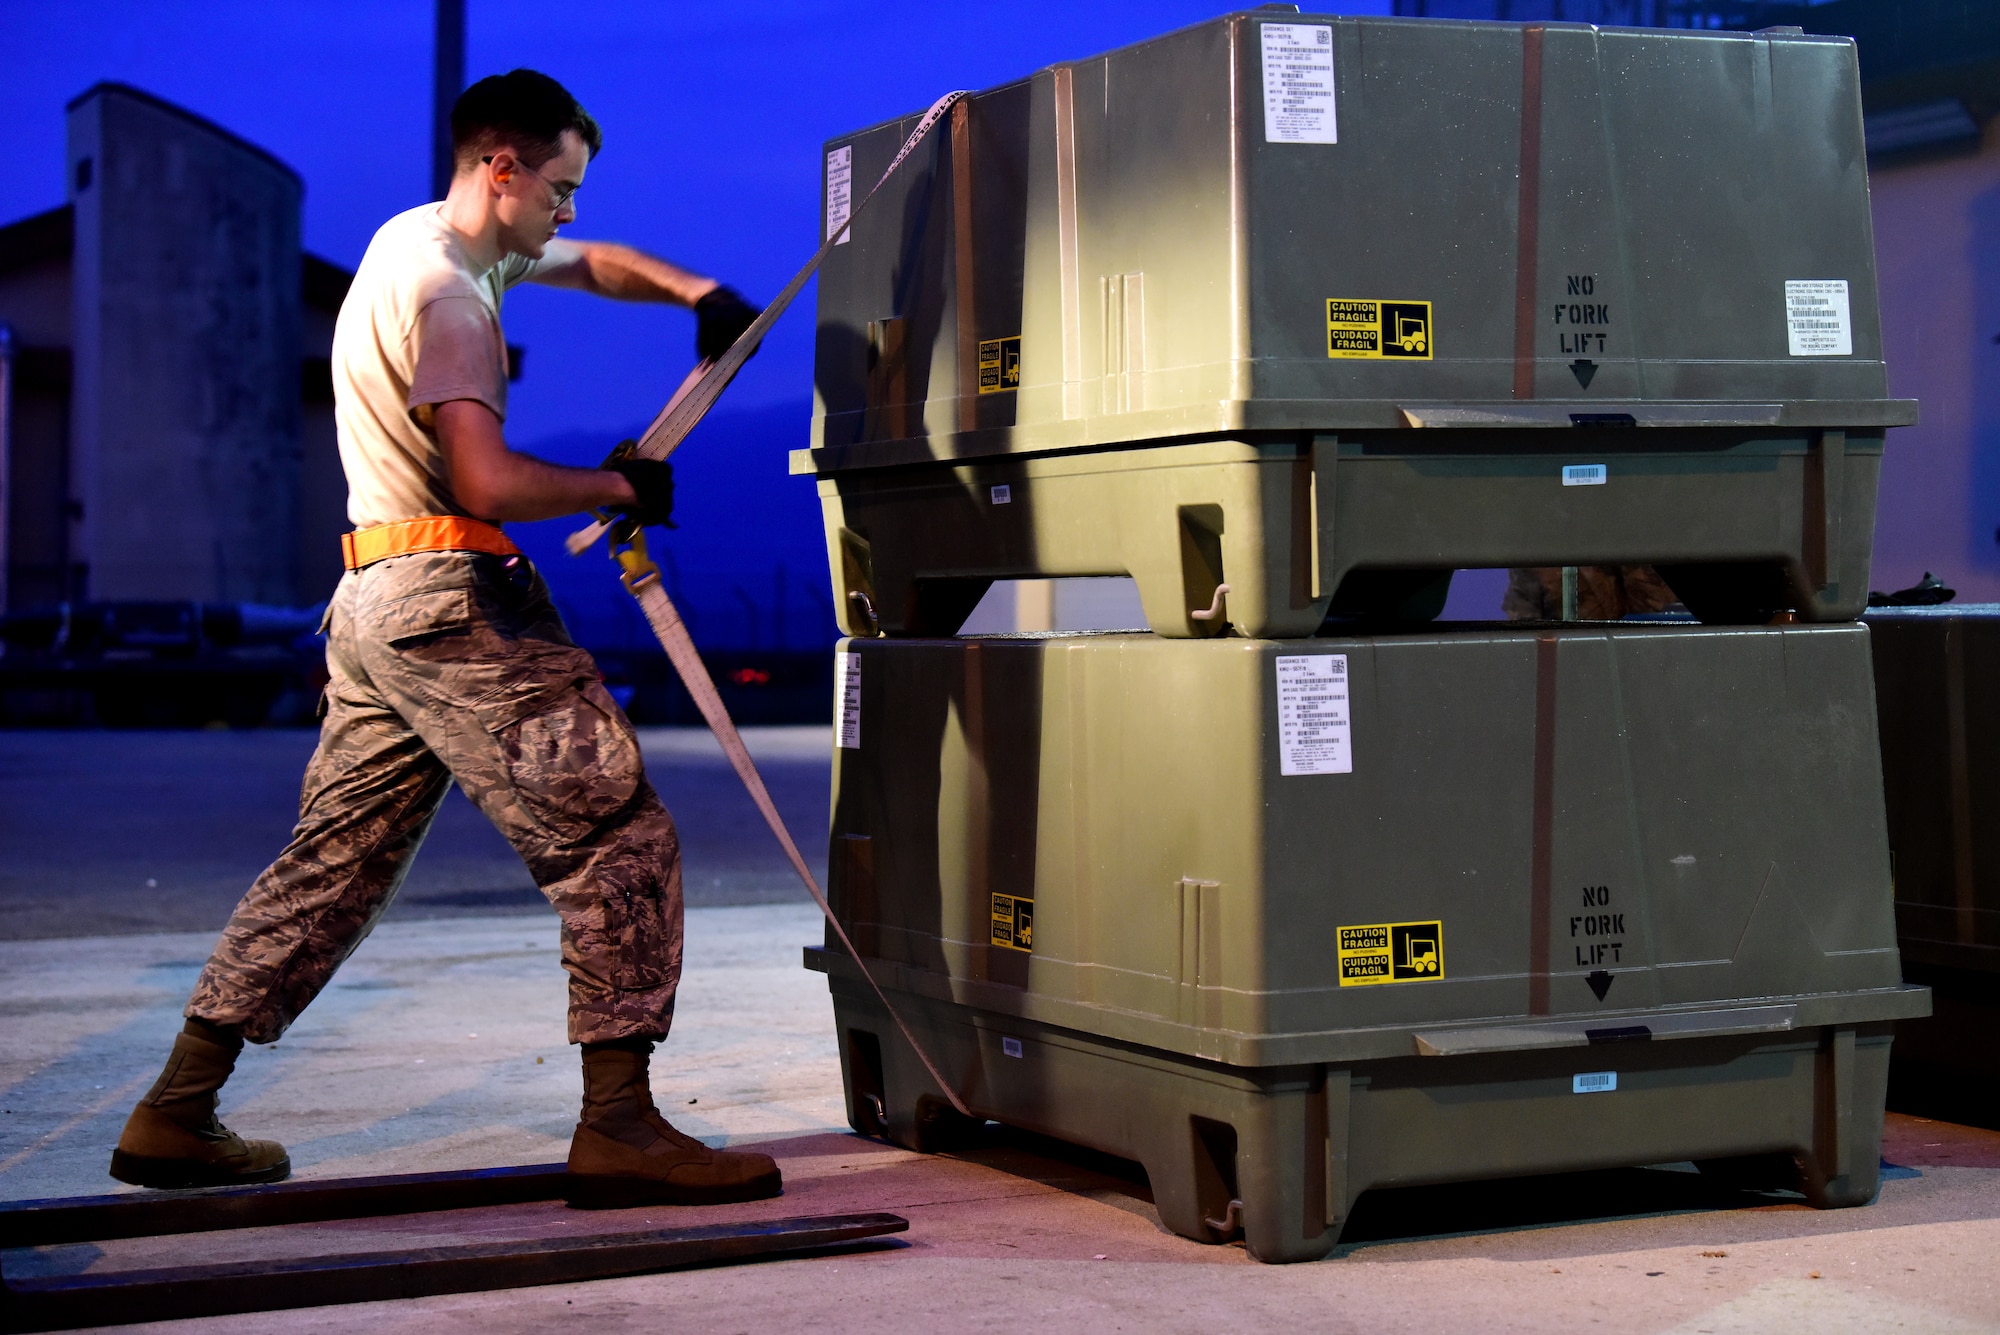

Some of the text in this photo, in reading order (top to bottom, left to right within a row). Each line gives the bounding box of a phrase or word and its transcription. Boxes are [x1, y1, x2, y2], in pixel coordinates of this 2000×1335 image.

[1567, 276, 1594, 295] NO
[1332, 303, 1375, 312] CAUTION
[1333, 313, 1375, 321] FRAGILE
[1555, 304, 1609, 324] FORK
[1332, 331, 1376, 340] CUIDADO
[1337, 340, 1372, 349] FRAGIL
[1560, 333, 1606, 353] LIFT
[1583, 886, 1609, 907] NO
[1570, 914, 1624, 937] FORK
[1343, 928, 1386, 938] CAUTION
[1344, 938, 1385, 948] FRAGILE
[1576, 943, 1622, 966] LIFT
[1344, 956, 1387, 966] CUIDADO
[1349, 966, 1384, 976] FRAGIL
